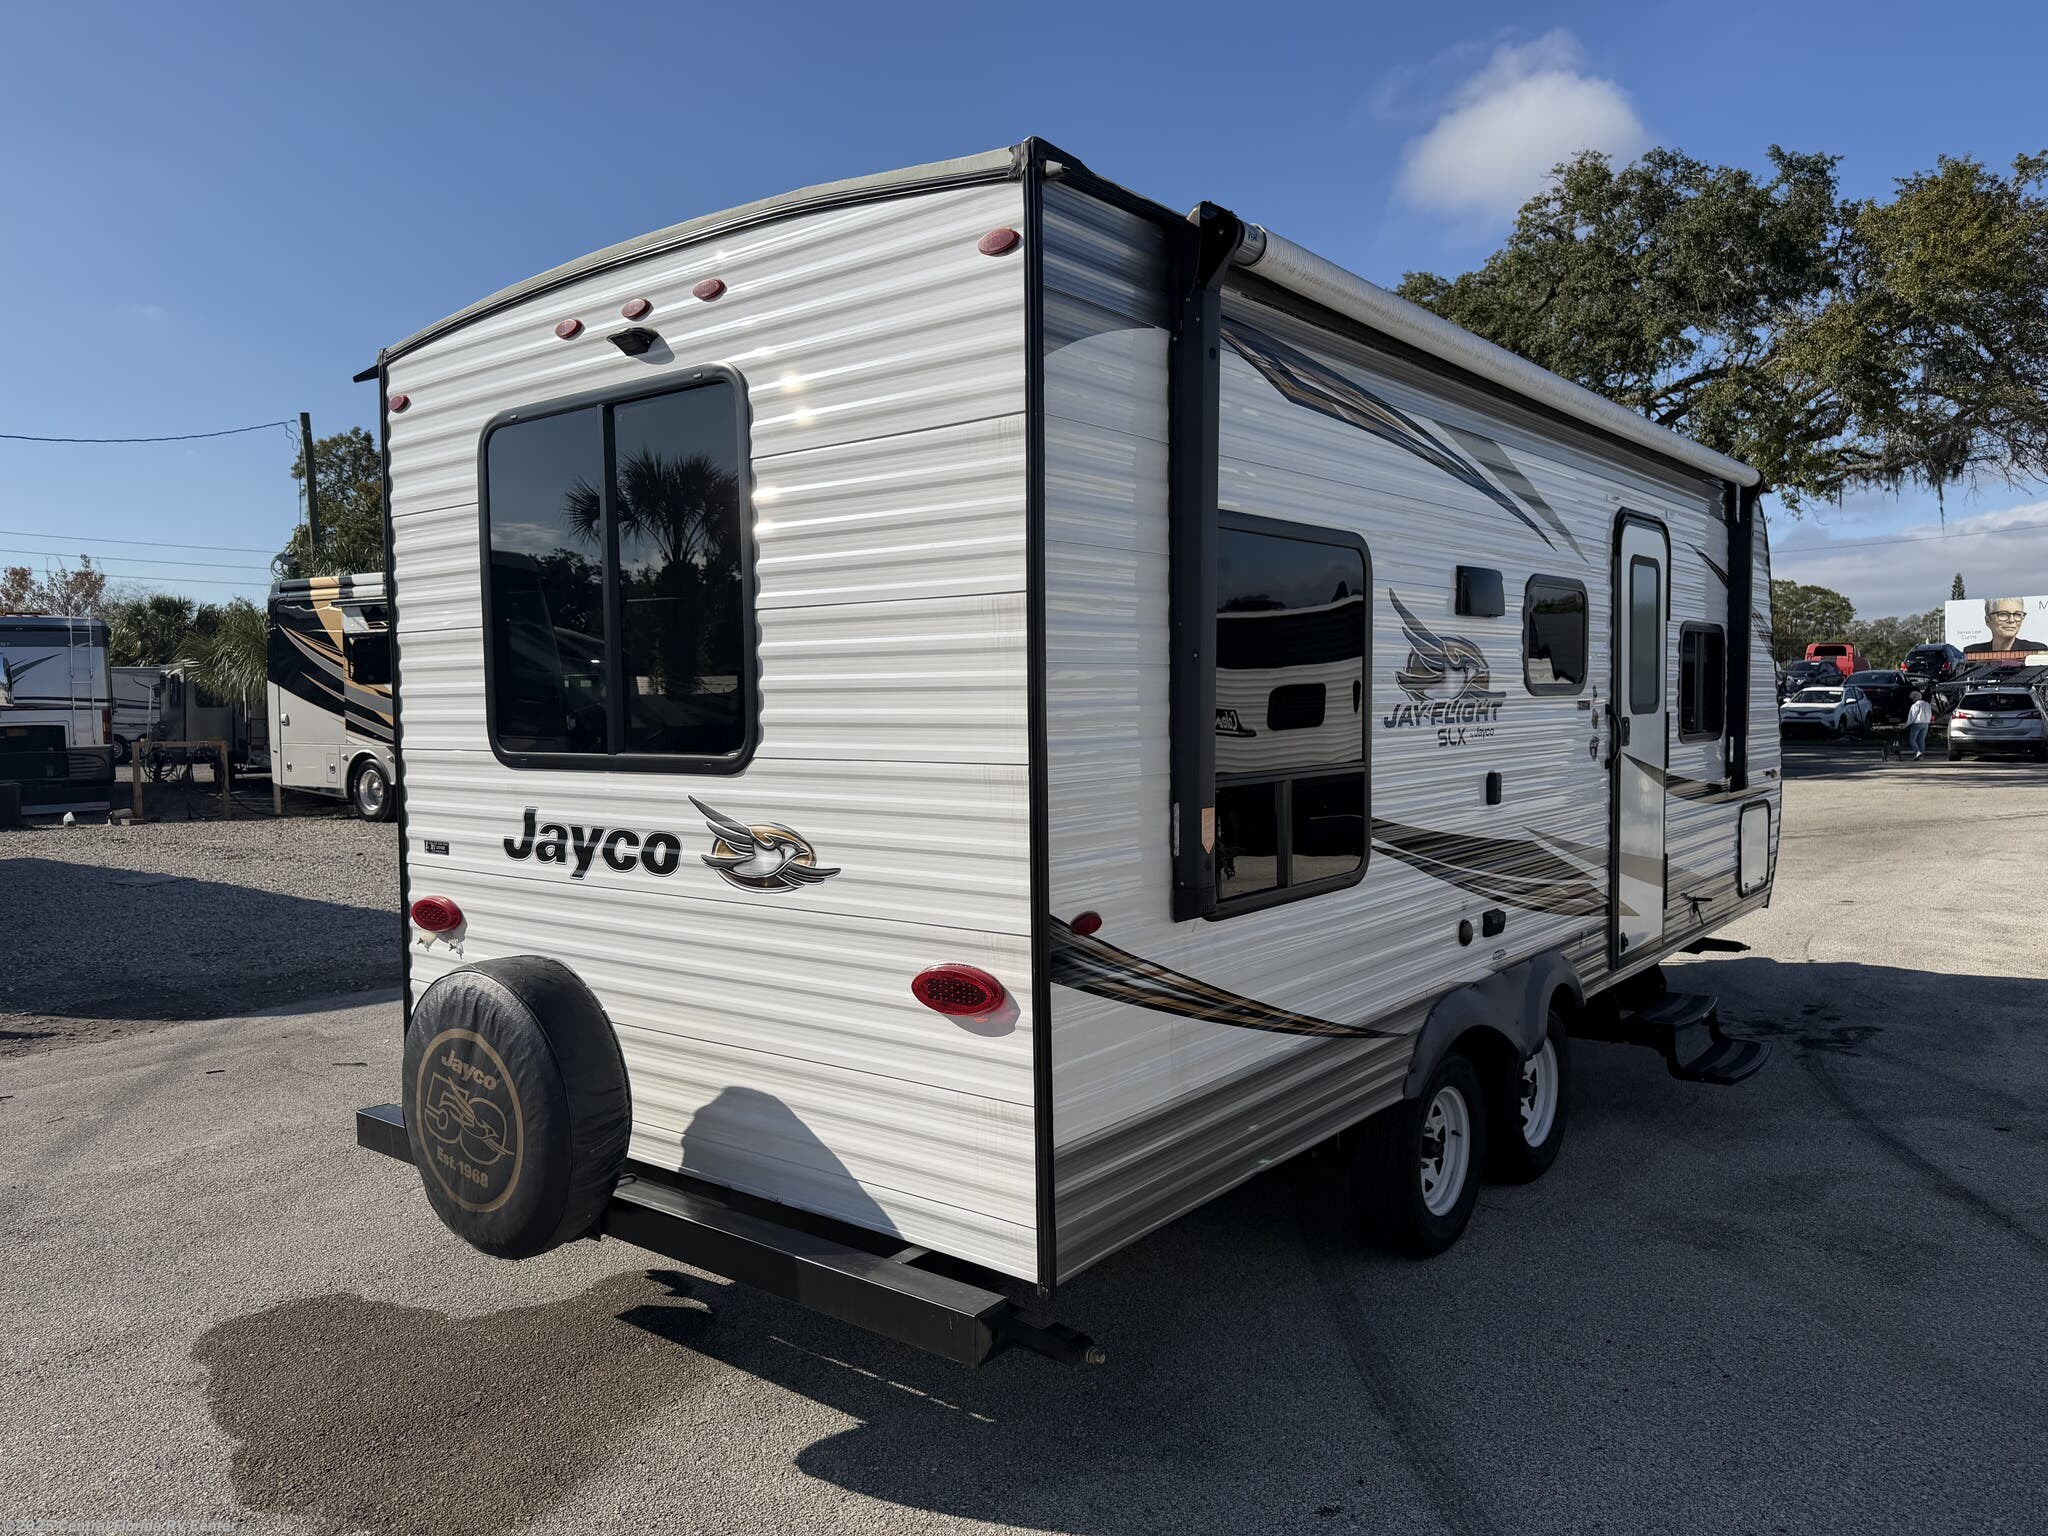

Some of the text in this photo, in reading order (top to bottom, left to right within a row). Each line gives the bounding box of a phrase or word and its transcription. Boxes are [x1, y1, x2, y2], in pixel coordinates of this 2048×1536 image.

[1383, 700, 1503, 728] JAY FLIGHT
[1437, 727, 1467, 747] SLX
[1474, 726, 1494, 741] Jayco
[502, 806, 683, 880] Jayco
[441, 1049, 498, 1091] Jayco
[437, 1144, 489, 1189] Est. 1968
